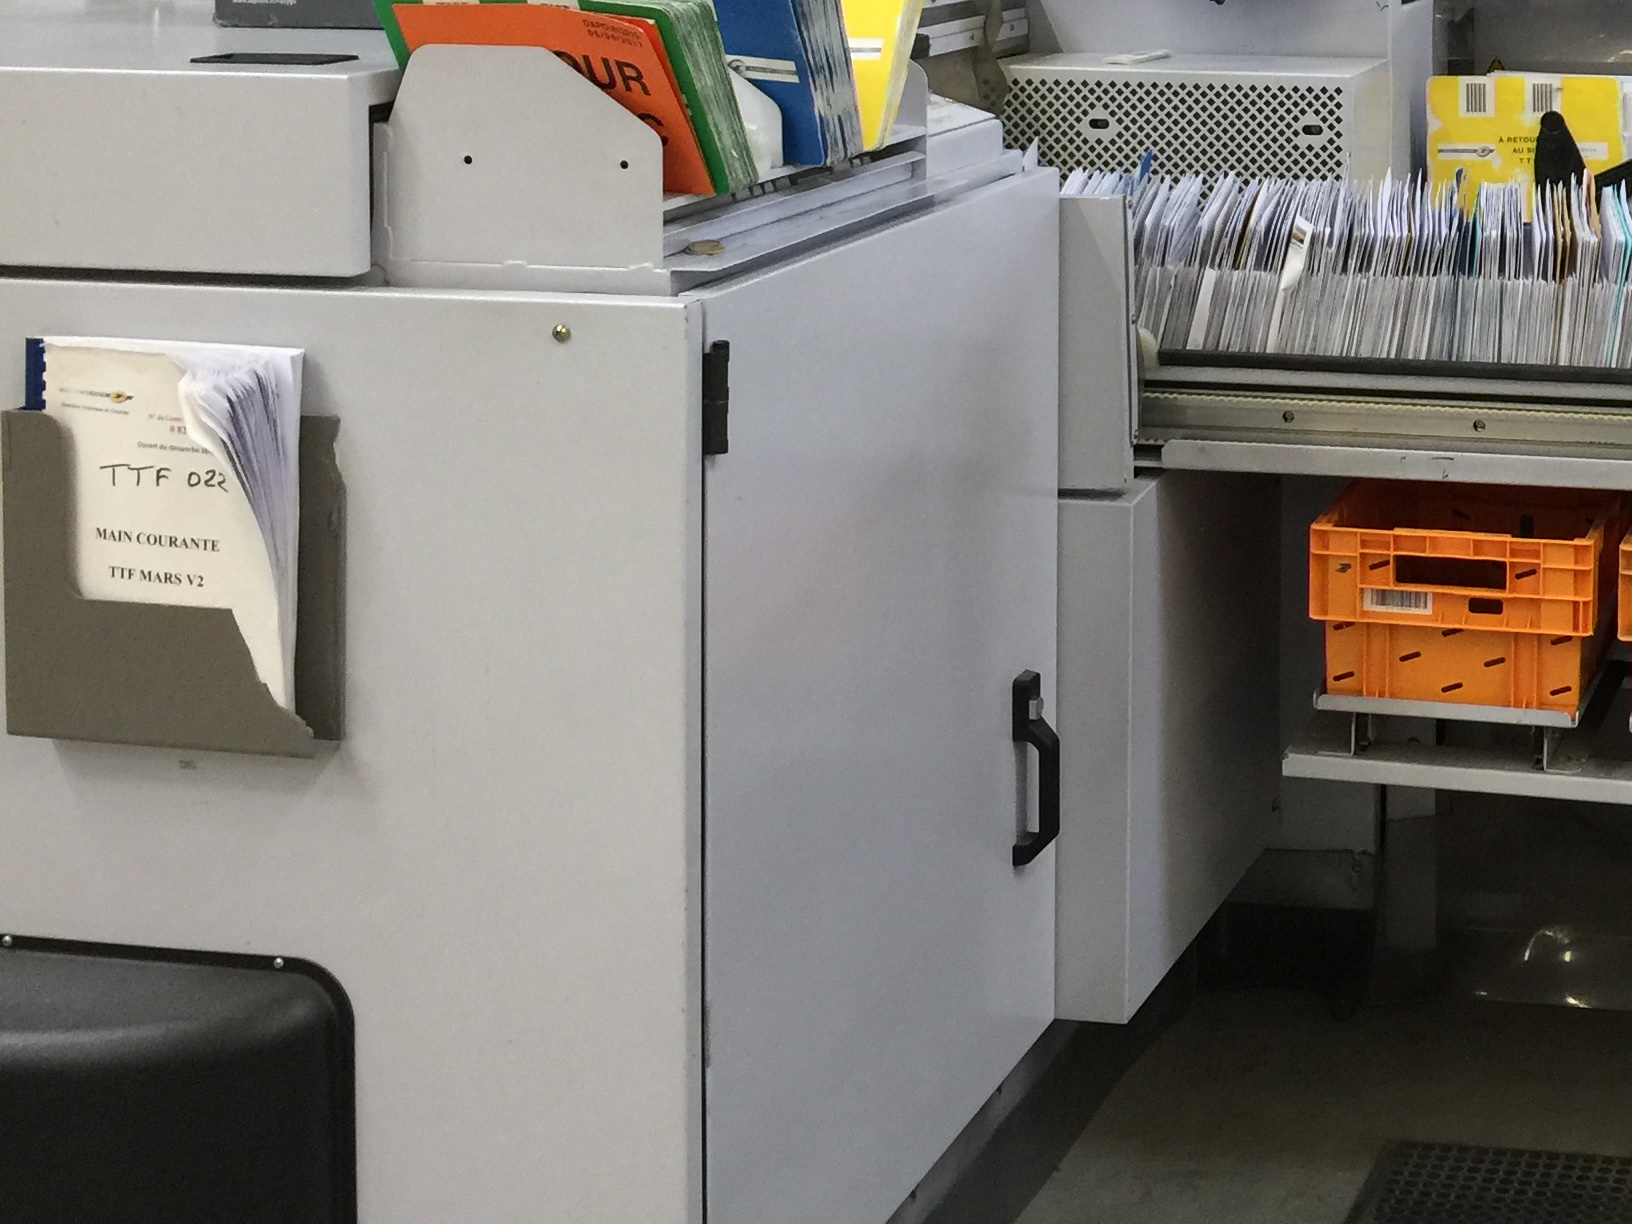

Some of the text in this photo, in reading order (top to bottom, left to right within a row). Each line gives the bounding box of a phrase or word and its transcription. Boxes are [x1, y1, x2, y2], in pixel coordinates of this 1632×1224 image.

[1507, 136, 1537, 144] RETOU
[100, 463, 171, 487] TTF
[96, 527, 220, 552] MAIN COURANTE
[109, 565, 204, 588] TTF MARS V2
